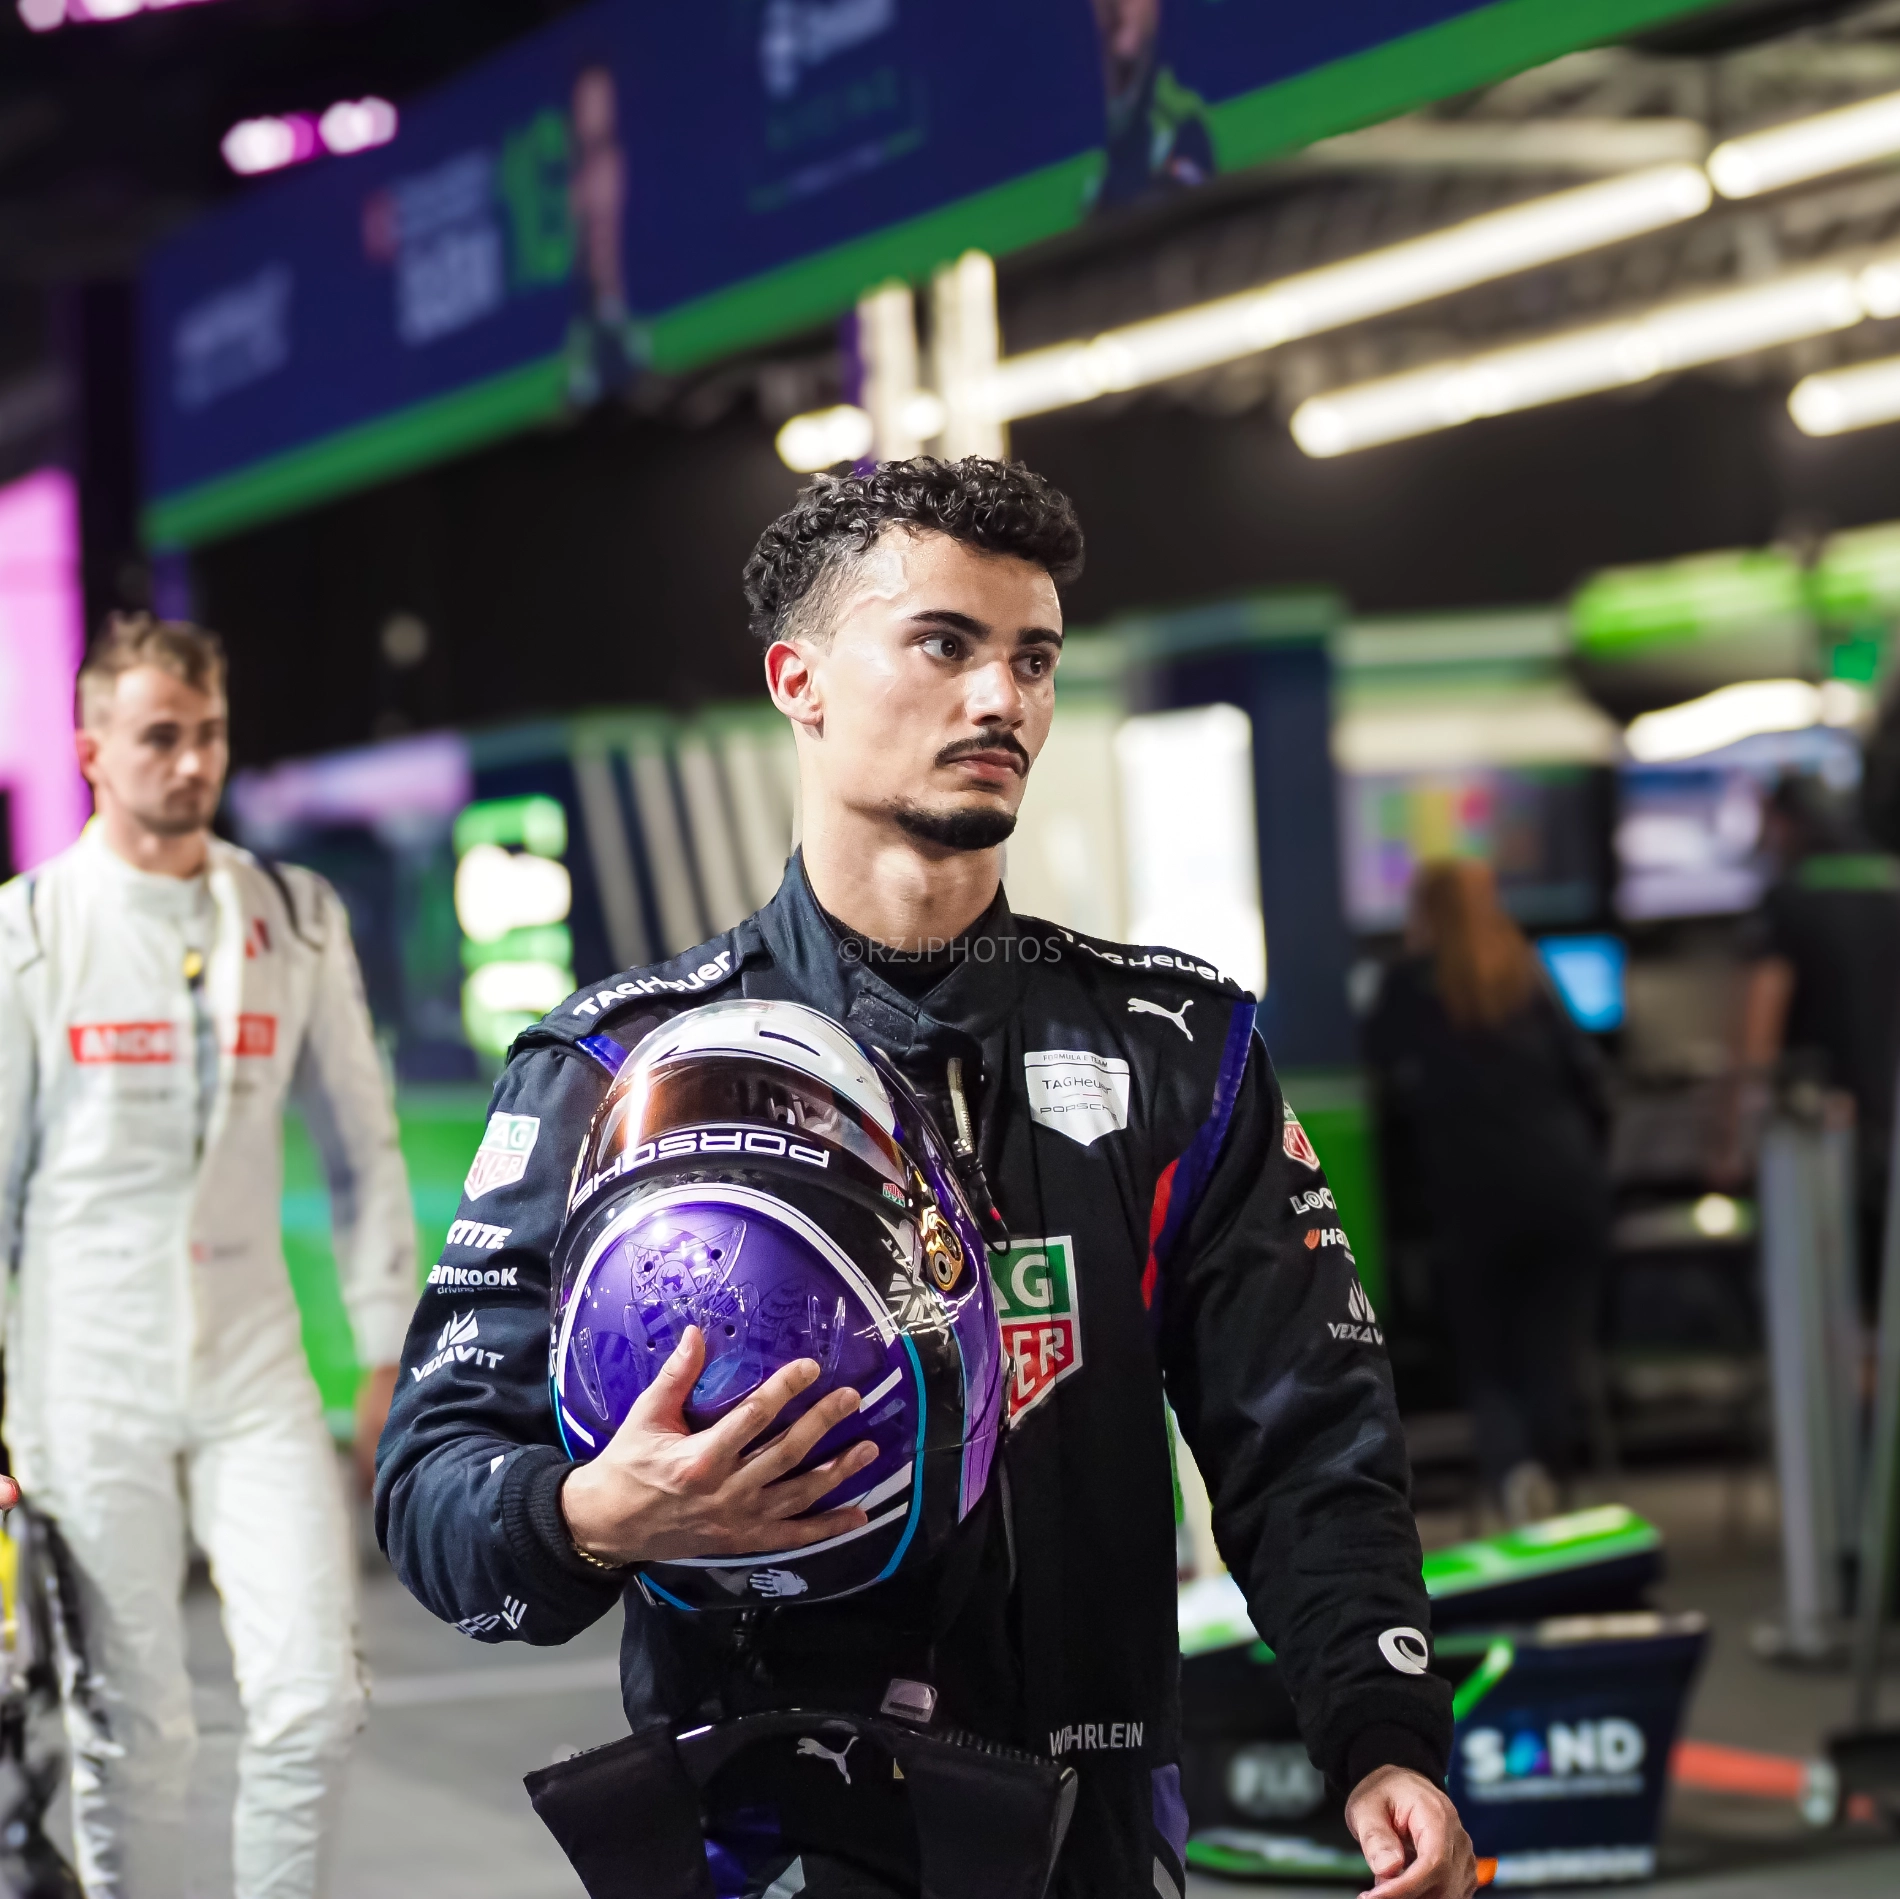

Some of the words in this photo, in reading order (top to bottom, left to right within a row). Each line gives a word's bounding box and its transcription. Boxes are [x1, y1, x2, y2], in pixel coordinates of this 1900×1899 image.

[1043, 1053, 1081, 1061] FORMULA
[484, 1121, 531, 1149] AG
[572, 1131, 830, 1212] PORSCHE
[1327, 1322, 1383, 1346] VEXAV
